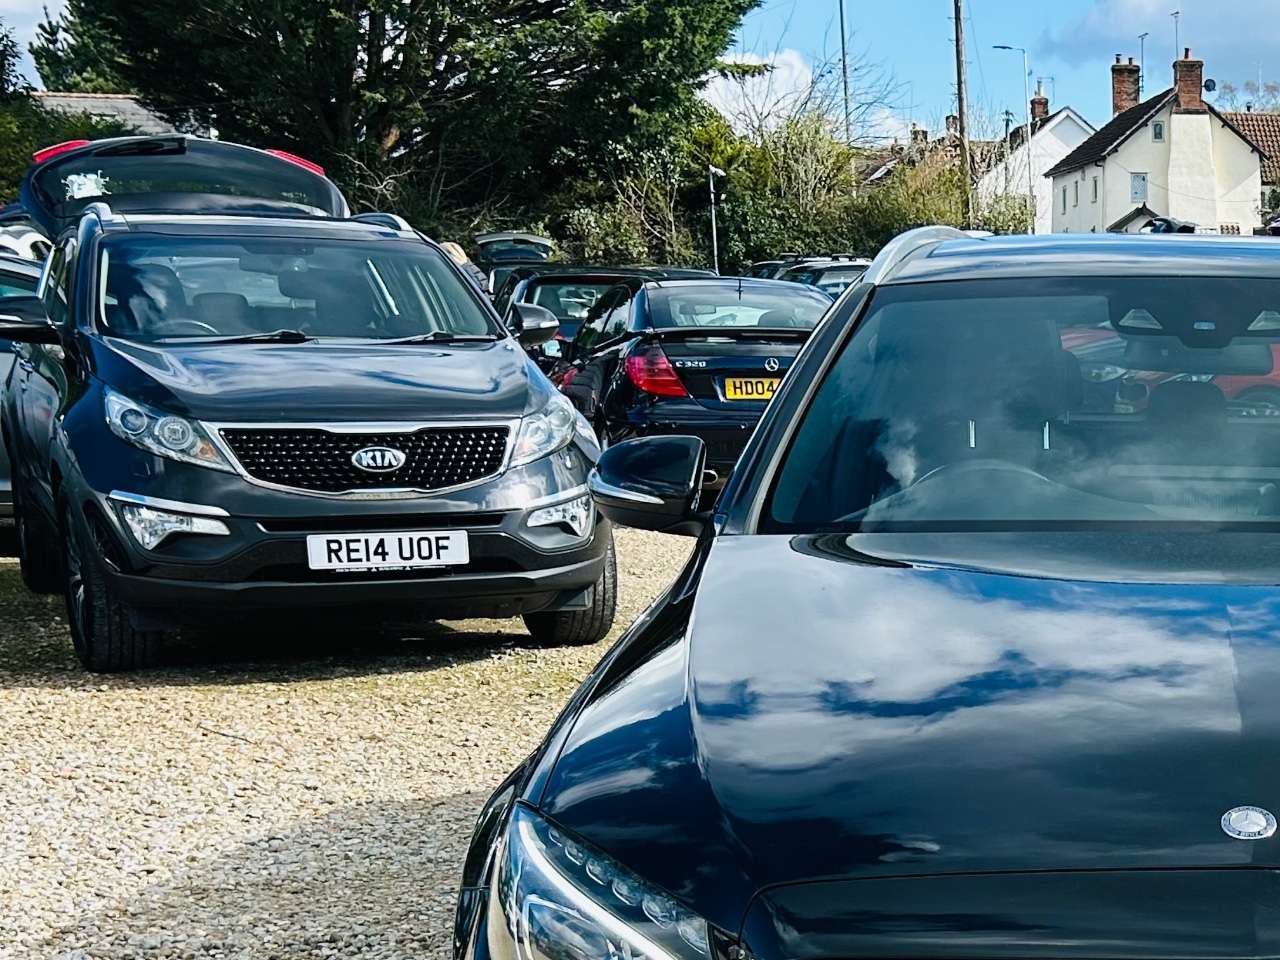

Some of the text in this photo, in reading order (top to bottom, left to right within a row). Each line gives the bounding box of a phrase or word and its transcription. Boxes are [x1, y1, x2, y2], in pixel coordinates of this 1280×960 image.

[732, 380, 778, 396] HD04
[360, 451, 398, 467] KIA
[326, 535, 451, 564] RE14 UOF
